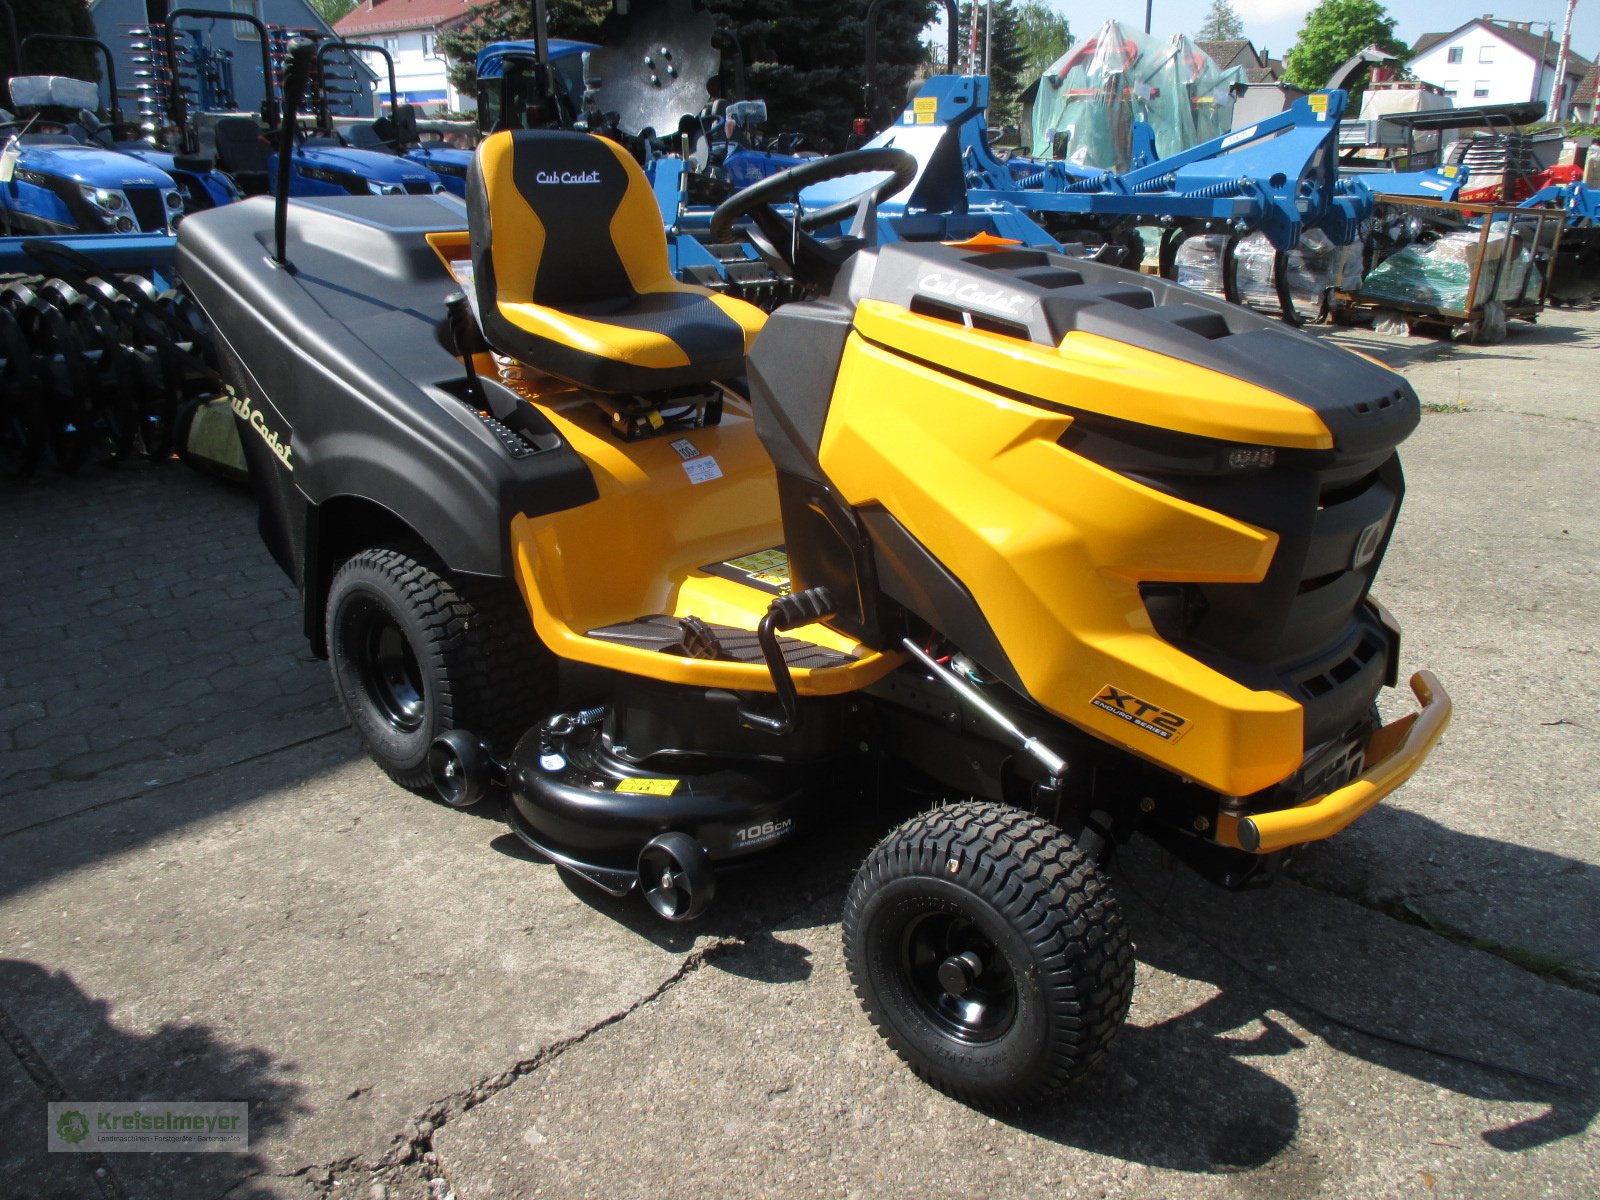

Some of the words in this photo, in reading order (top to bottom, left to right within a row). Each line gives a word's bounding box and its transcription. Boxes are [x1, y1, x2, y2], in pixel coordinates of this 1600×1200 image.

[536, 171, 560, 184] Cub
[561, 170, 601, 184] Cadet
[919, 273, 960, 296] Cub
[955, 283, 1025, 314] Cadet
[249, 409, 294, 472] Cadet
[1093, 699, 1133, 721] ENDURO
[1133, 719, 1168, 738] SERIES
[1097, 687, 1186, 733] XT2
